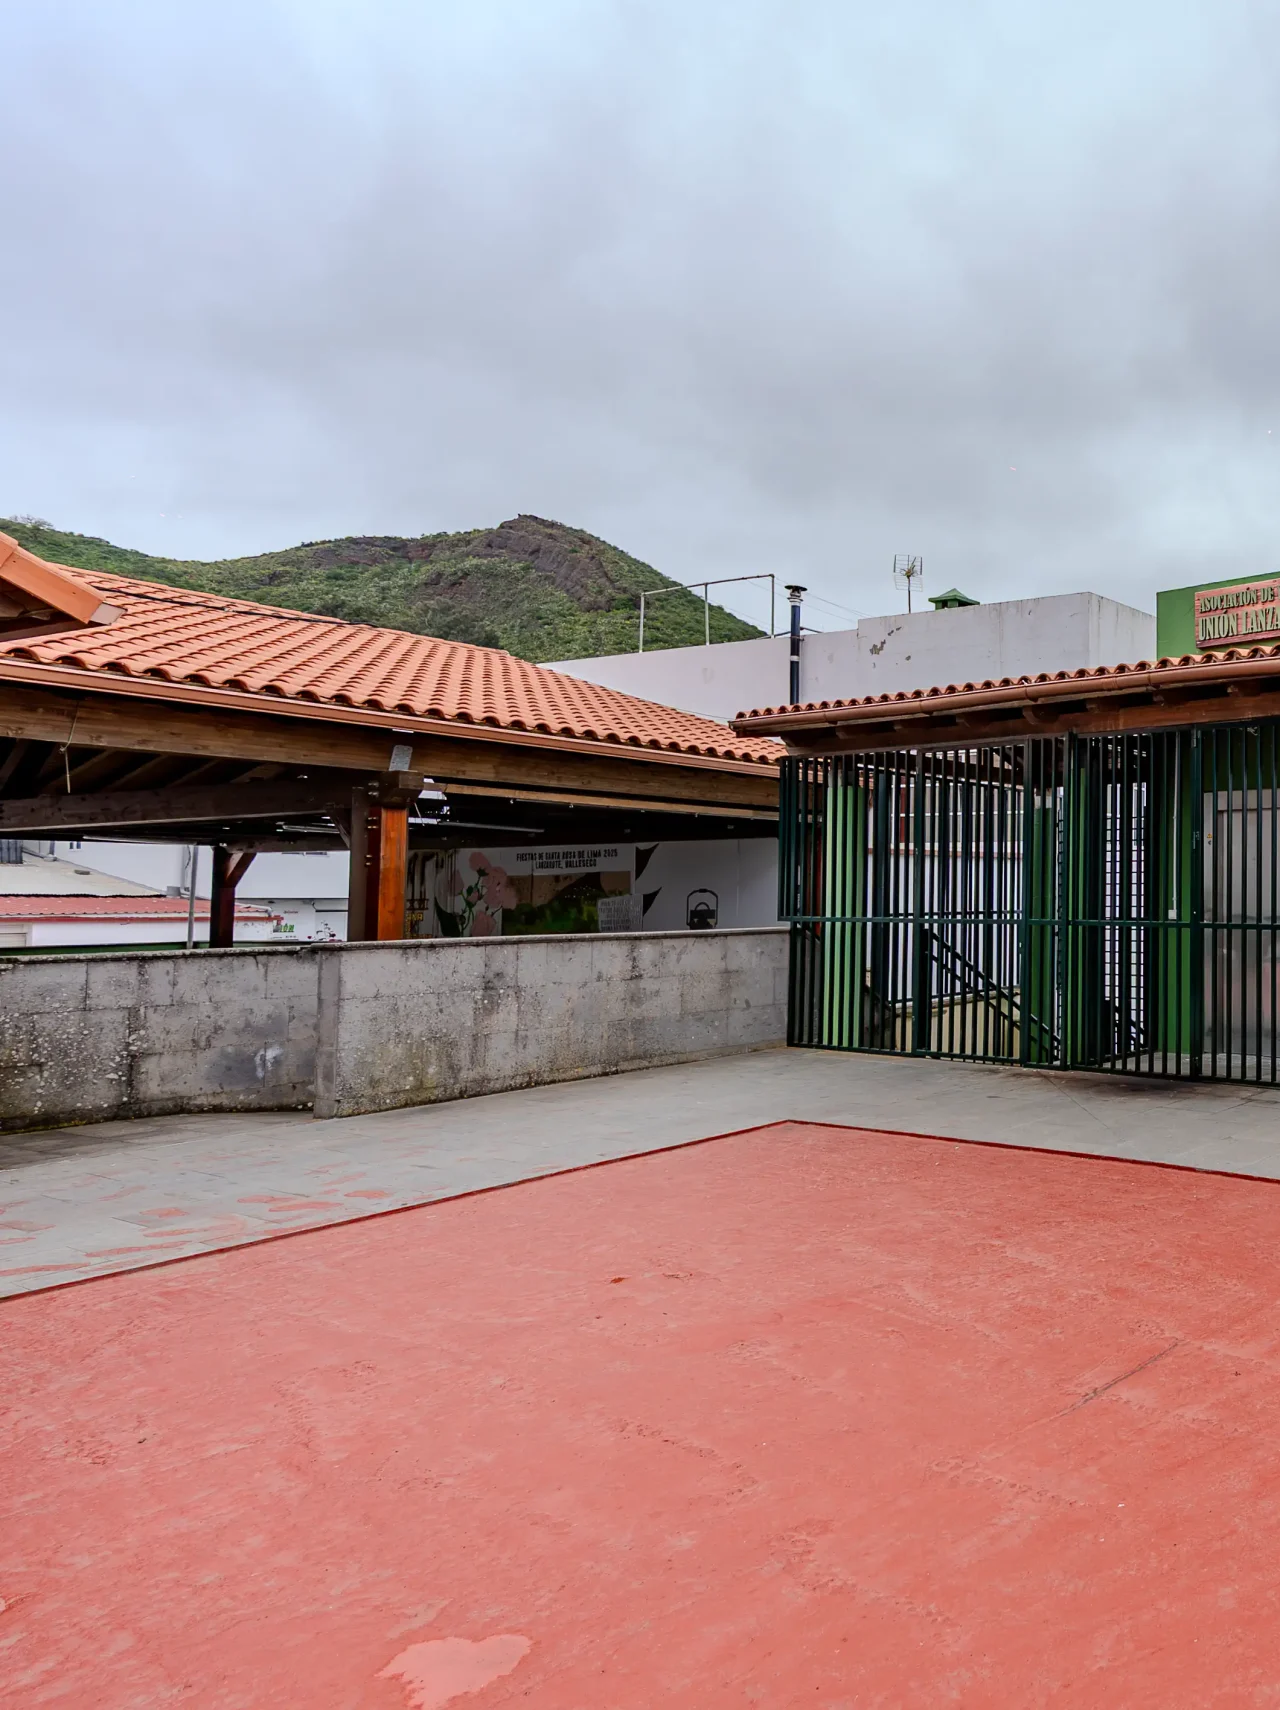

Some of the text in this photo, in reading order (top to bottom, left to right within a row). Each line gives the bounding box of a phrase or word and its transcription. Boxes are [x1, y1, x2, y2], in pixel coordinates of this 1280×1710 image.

[1200, 588, 1258, 613] ASOCIACIÓN
[1261, 586, 1275, 603] DE
[1199, 610, 1238, 641] UNIÓN
[517, 852, 537, 861] FIESTAS
[545, 851, 560, 860] SANTA
[577, 850, 585, 859] DE
[587, 849, 601, 859] LIMA
[604, 848, 618, 857] 2025
[565, 859, 597, 869] VALLESECO
